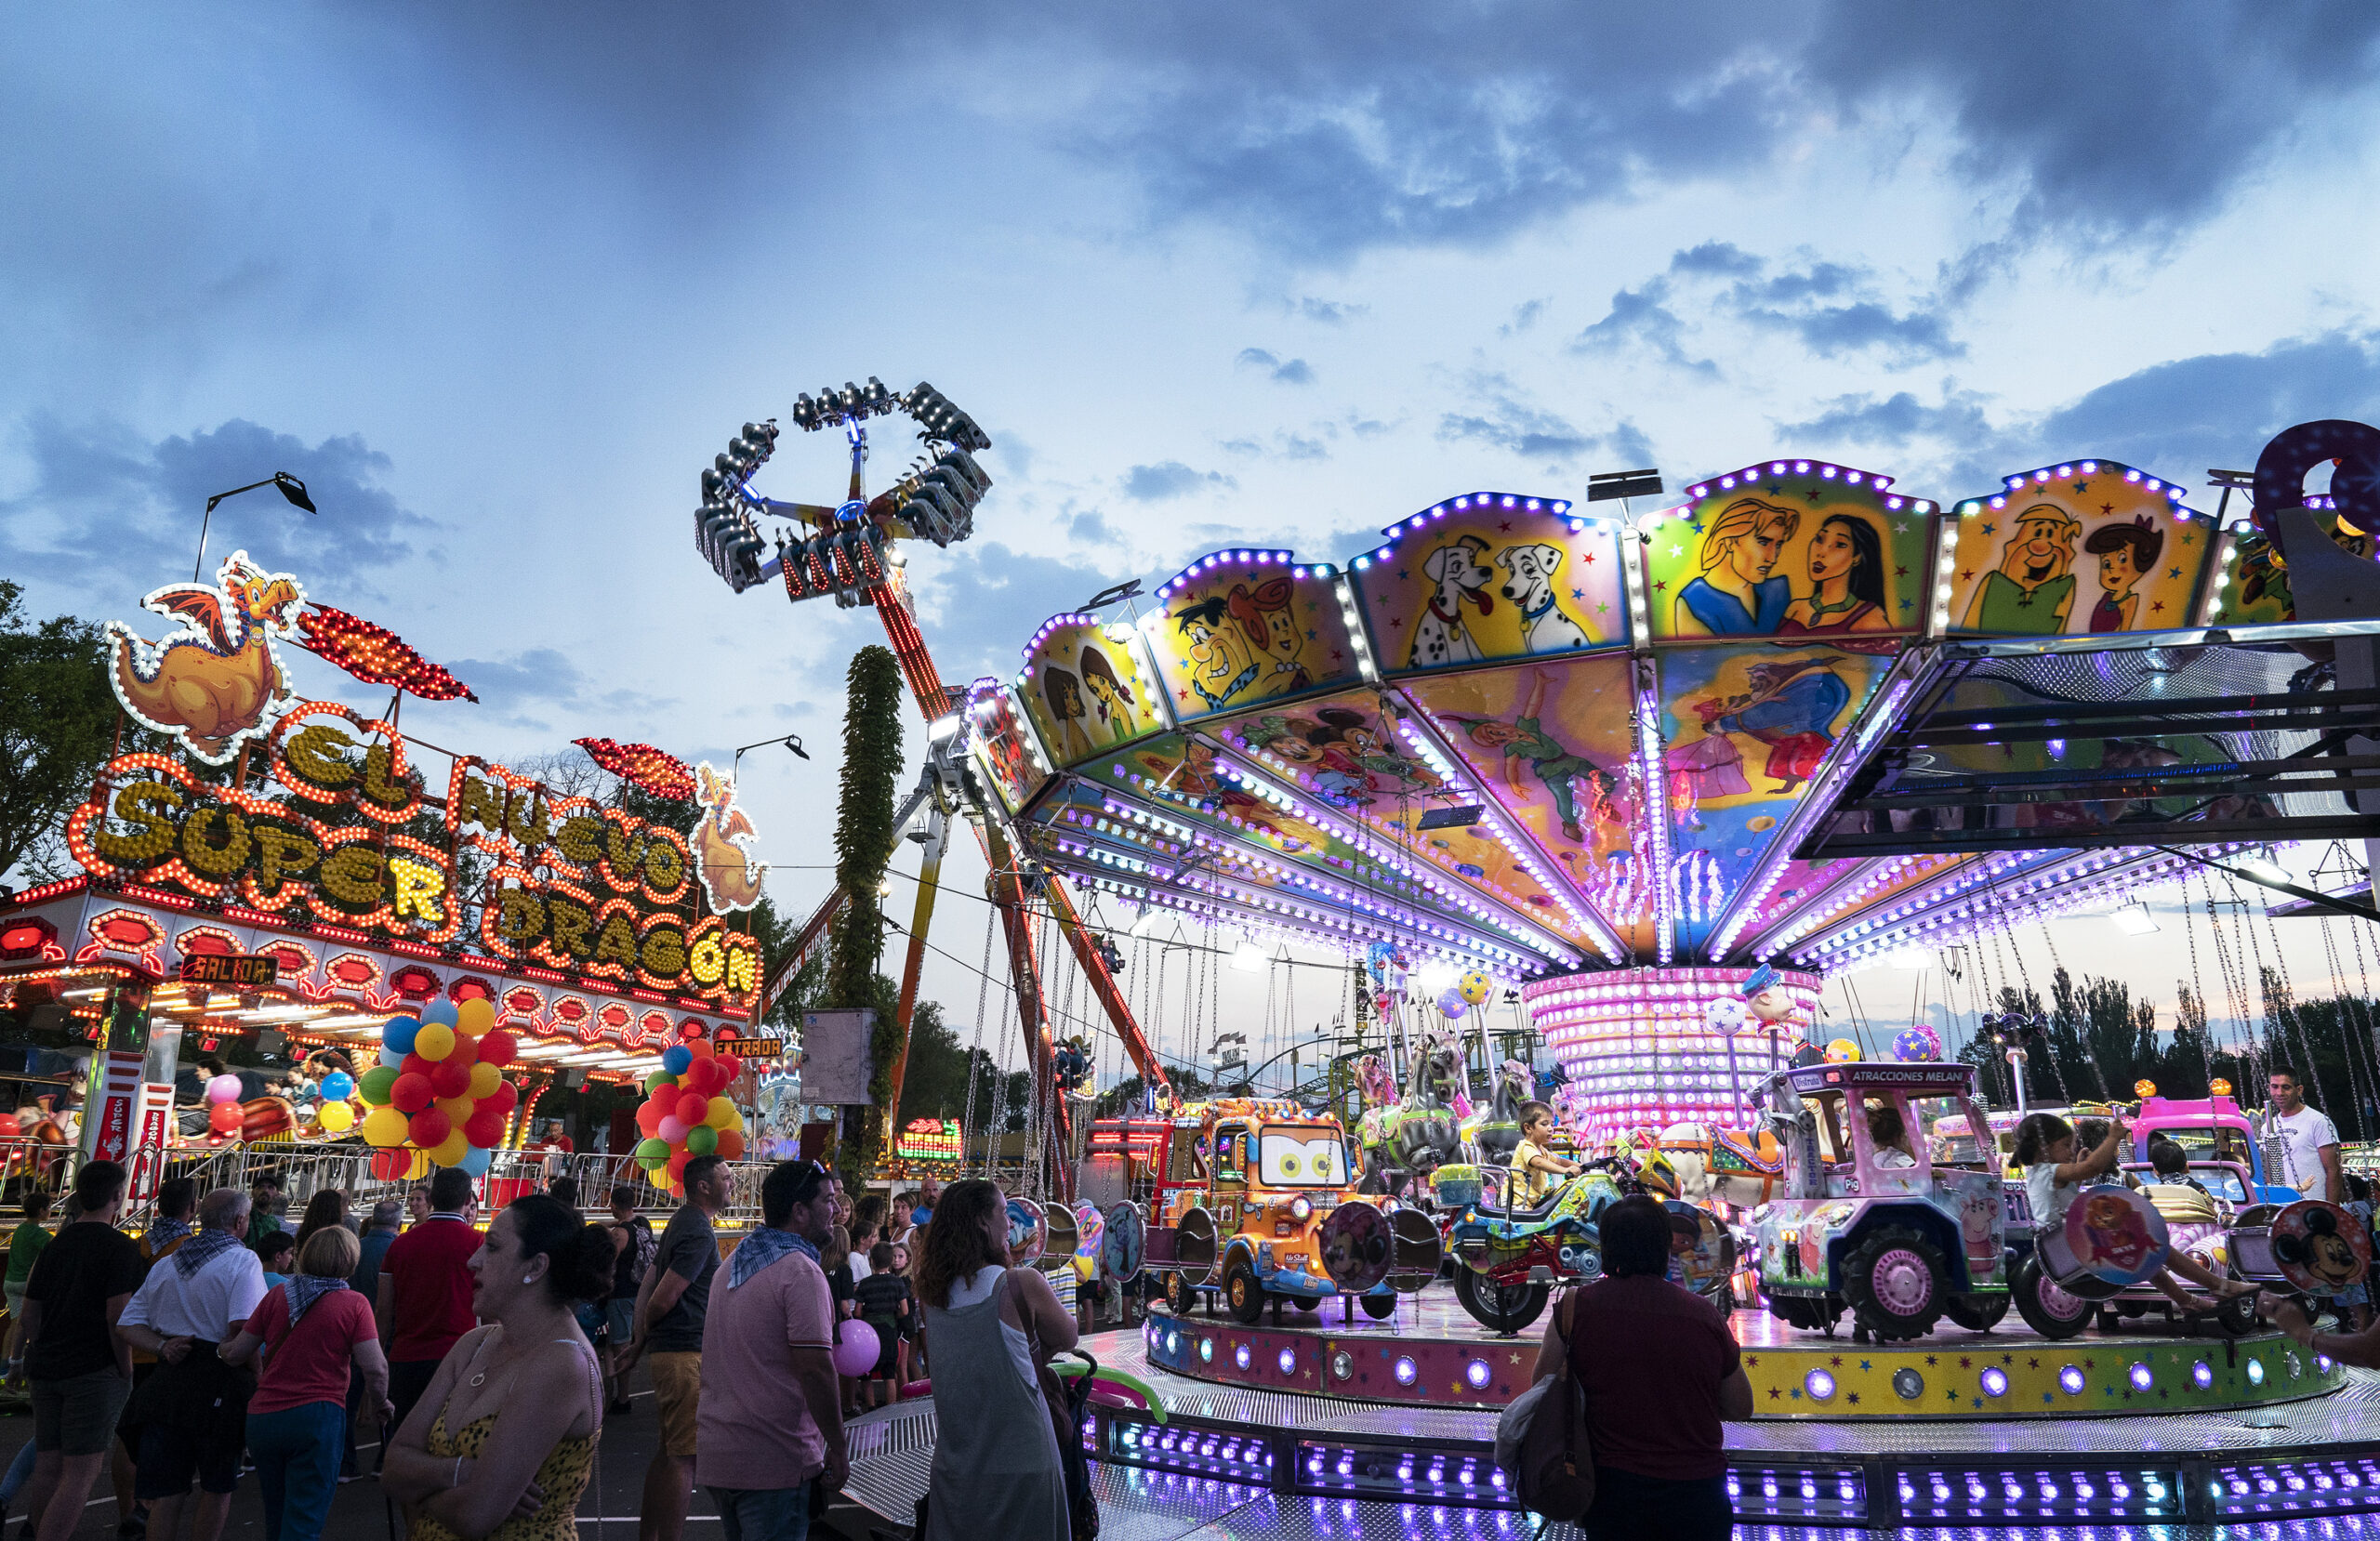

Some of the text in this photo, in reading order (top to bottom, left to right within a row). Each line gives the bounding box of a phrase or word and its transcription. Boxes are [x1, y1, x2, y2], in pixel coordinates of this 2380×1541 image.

[287, 725, 682, 888] EL NUEVO
[96, 781, 757, 992] SUPER DRAGÓN
[770, 922, 828, 1006] SUPER GIRO
[715, 1040, 781, 1057] ENTRADA
[1853, 1071, 1964, 1082] ATRACCIONES MELANI
[110, 1099, 124, 1133] SUPER
[1844, 1178, 1859, 1192] Pig
